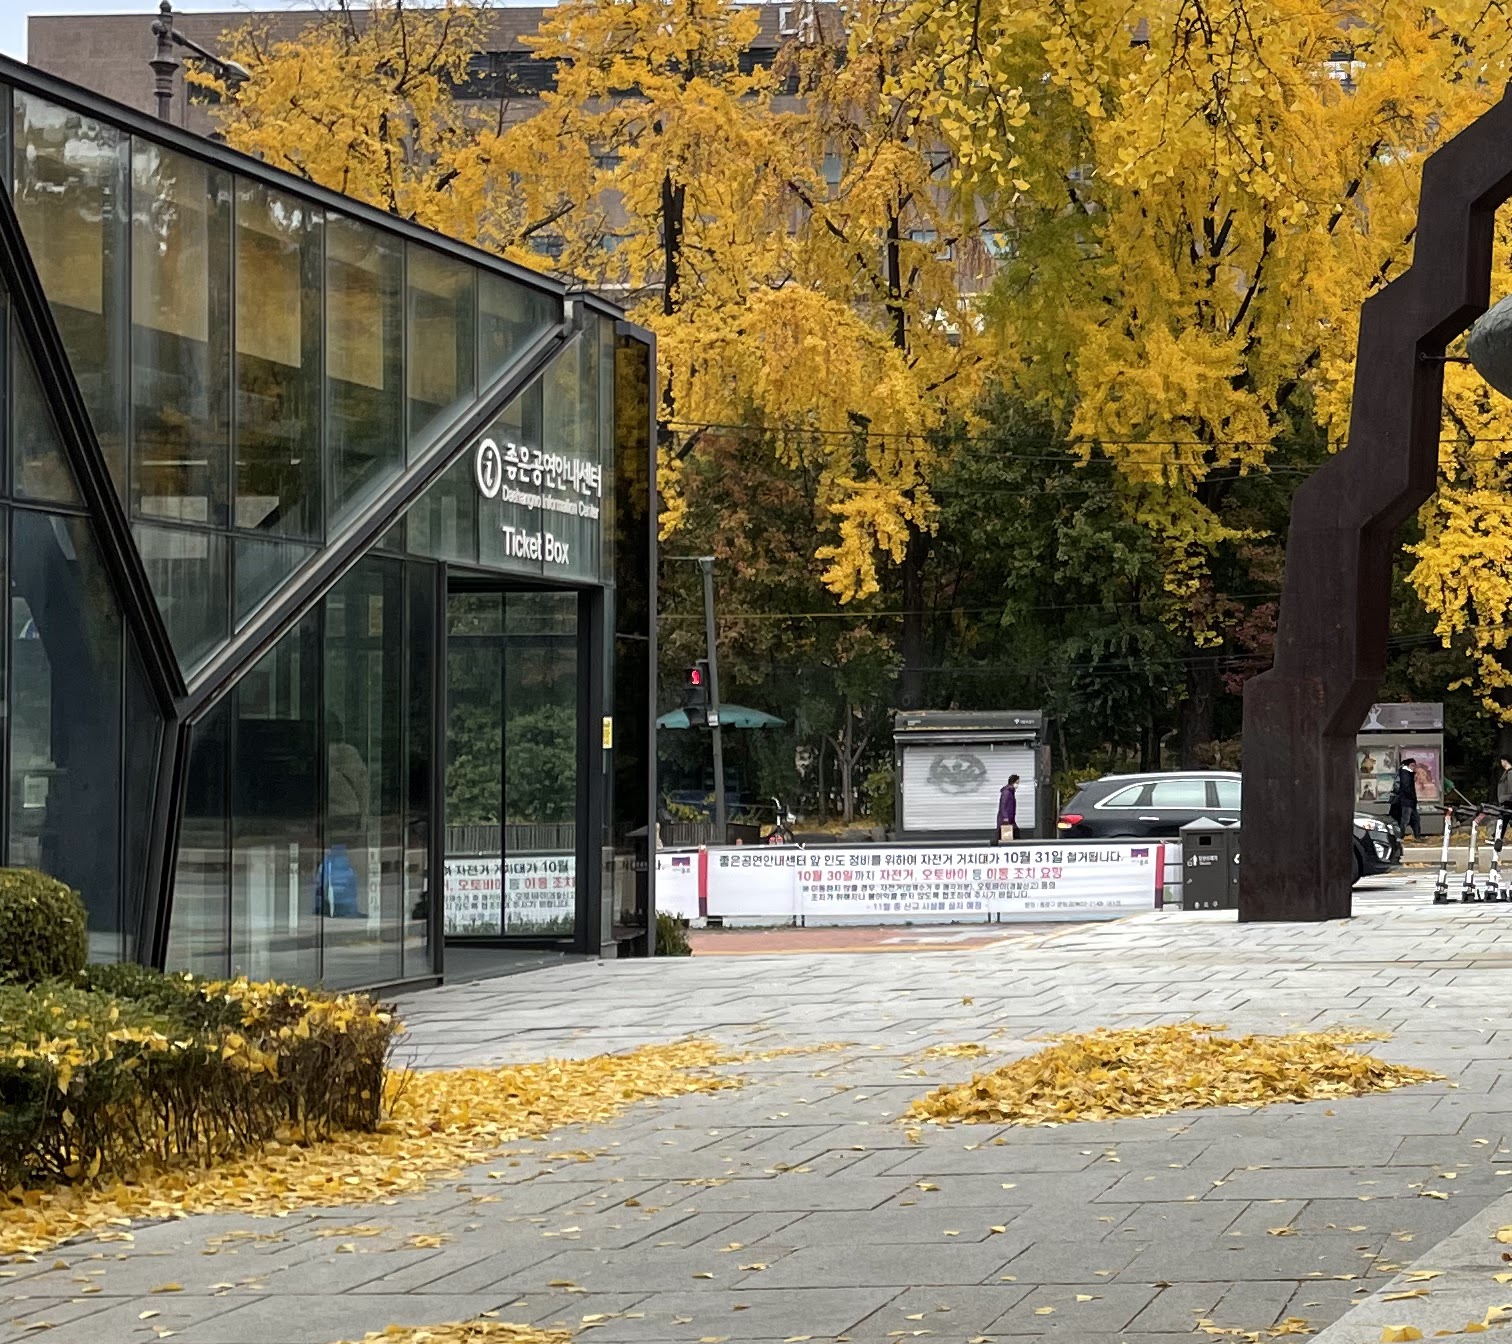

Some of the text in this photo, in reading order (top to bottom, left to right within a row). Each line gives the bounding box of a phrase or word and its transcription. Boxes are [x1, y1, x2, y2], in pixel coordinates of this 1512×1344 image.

[504, 442, 602, 498] 좋은공연안내센터
[502, 525, 570, 565] Ticket Box
[720, 855, 806, 868] 좋은공연안내센터
[809, 855, 821, 867] 앞
[824, 855, 846, 867] 인도
[849, 855, 881, 867] 정비를
[884, 854, 917, 866] 위하여
[921, 853, 952, 865] 자전거
[959, 852, 1000, 865] 거치대가
[1004, 851, 1031, 865] 10월
[1034, 850, 1063, 864] 31일
[798, 870, 822, 882] 10월
[826, 870, 876, 882] 30일까지
[922, 868, 968, 881] 오토바이
[987, 867, 1009, 881] 이동
[1013, 867, 1036, 879] 조치
[1040, 866, 1064, 879] 요망
